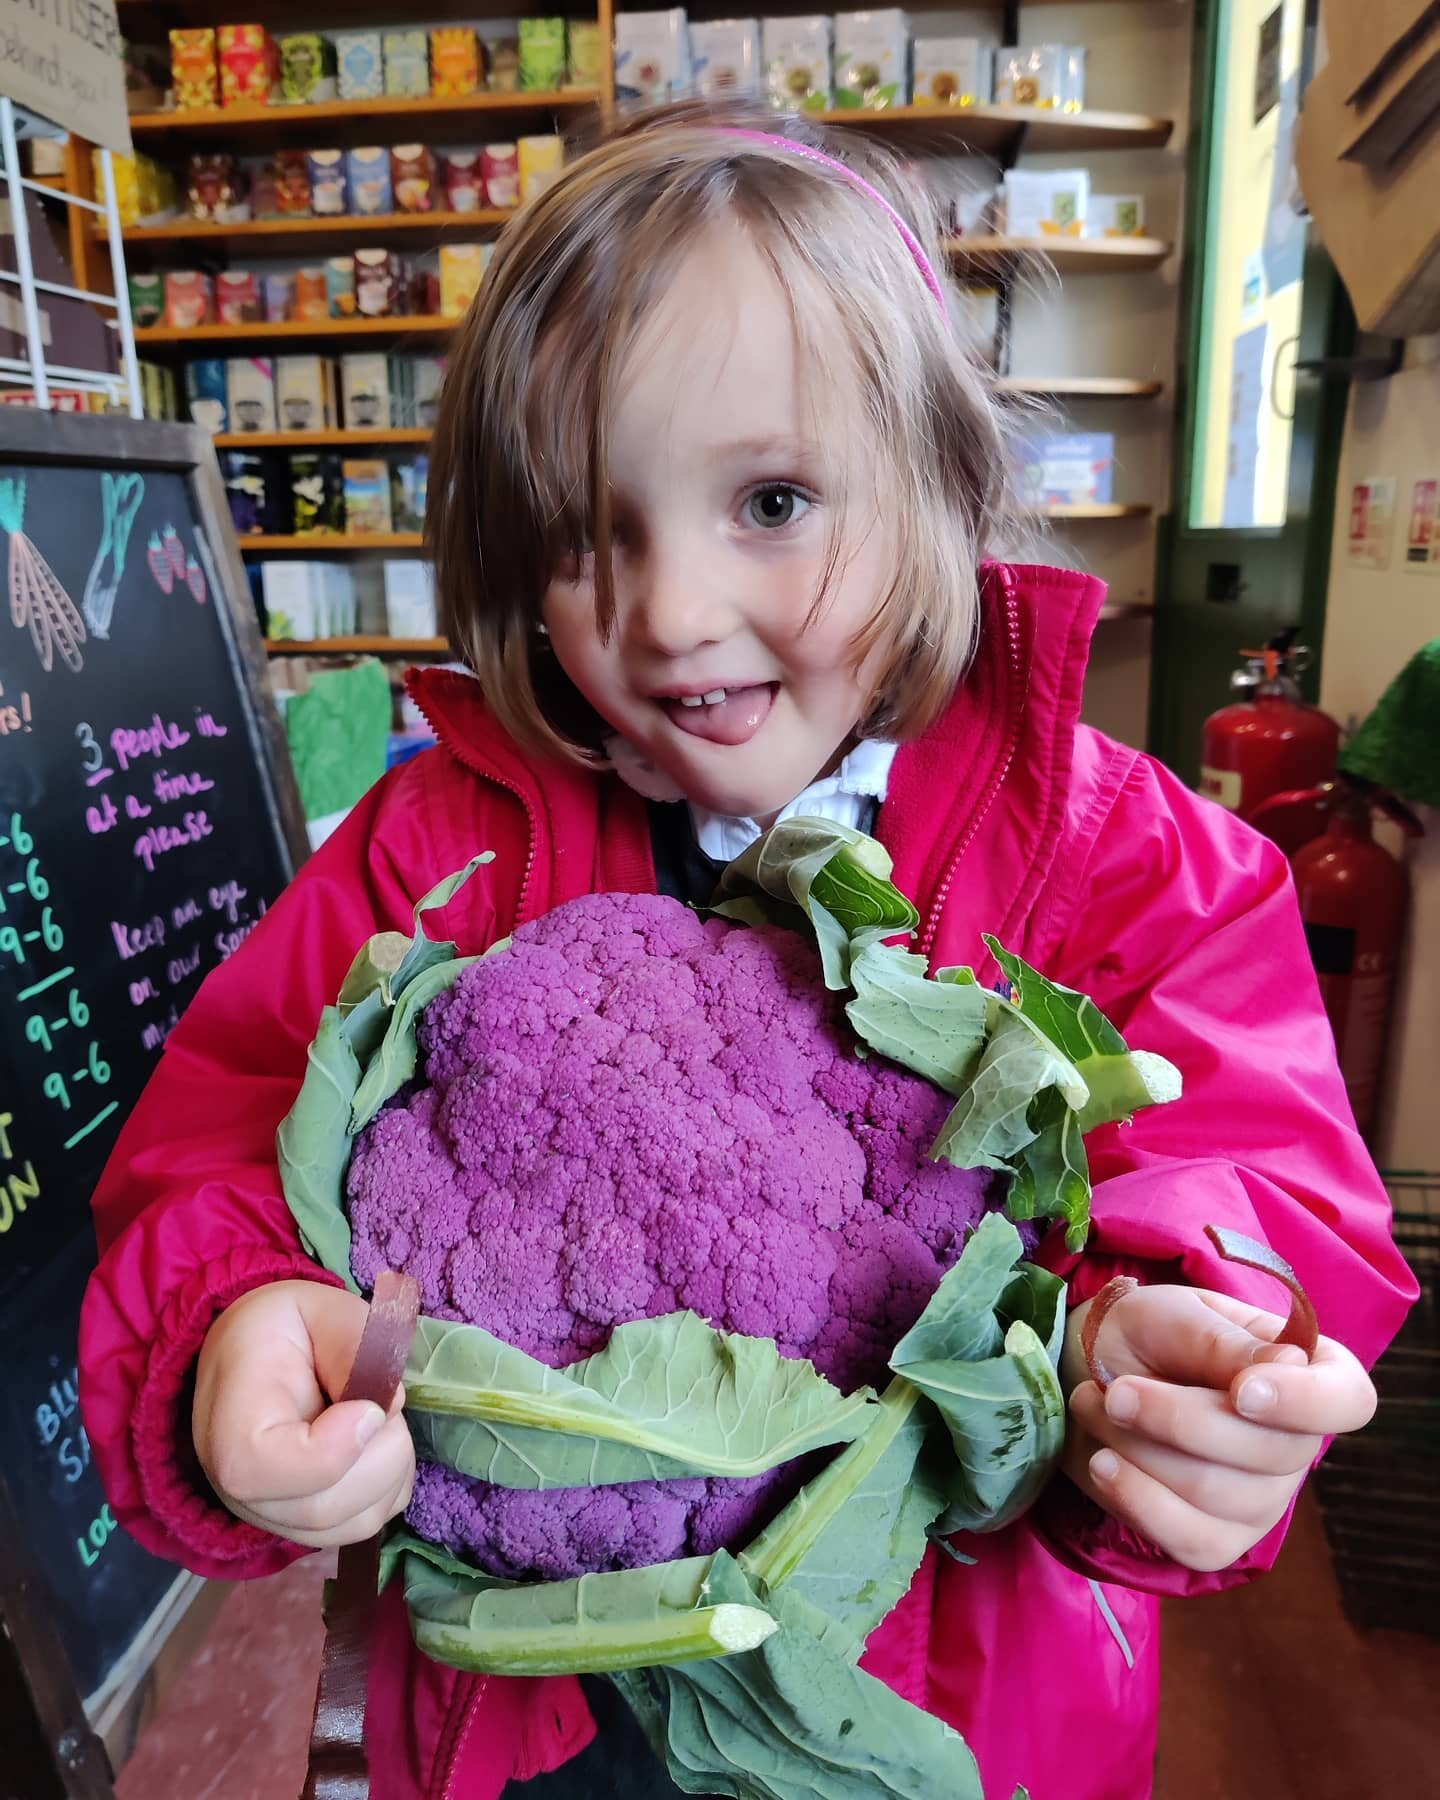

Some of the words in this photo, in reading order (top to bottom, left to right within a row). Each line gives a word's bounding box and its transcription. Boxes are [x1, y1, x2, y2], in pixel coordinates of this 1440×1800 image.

[75, 722, 103, 772] 3
[110, 713, 191, 771] people
[193, 705, 228, 738] in
[86, 794, 118, 834] at
[125, 794, 153, 819] a
[153, 769, 215, 804] time
[133, 810, 214, 872] please
[111, 920, 166, 961] Keep
[171, 898, 203, 929] an
[208, 879, 248, 924] eye
[25, 988, 90, 1053] 9-6
[128, 976, 161, 1007] on
[43, 1040, 112, 1112] 9-6
